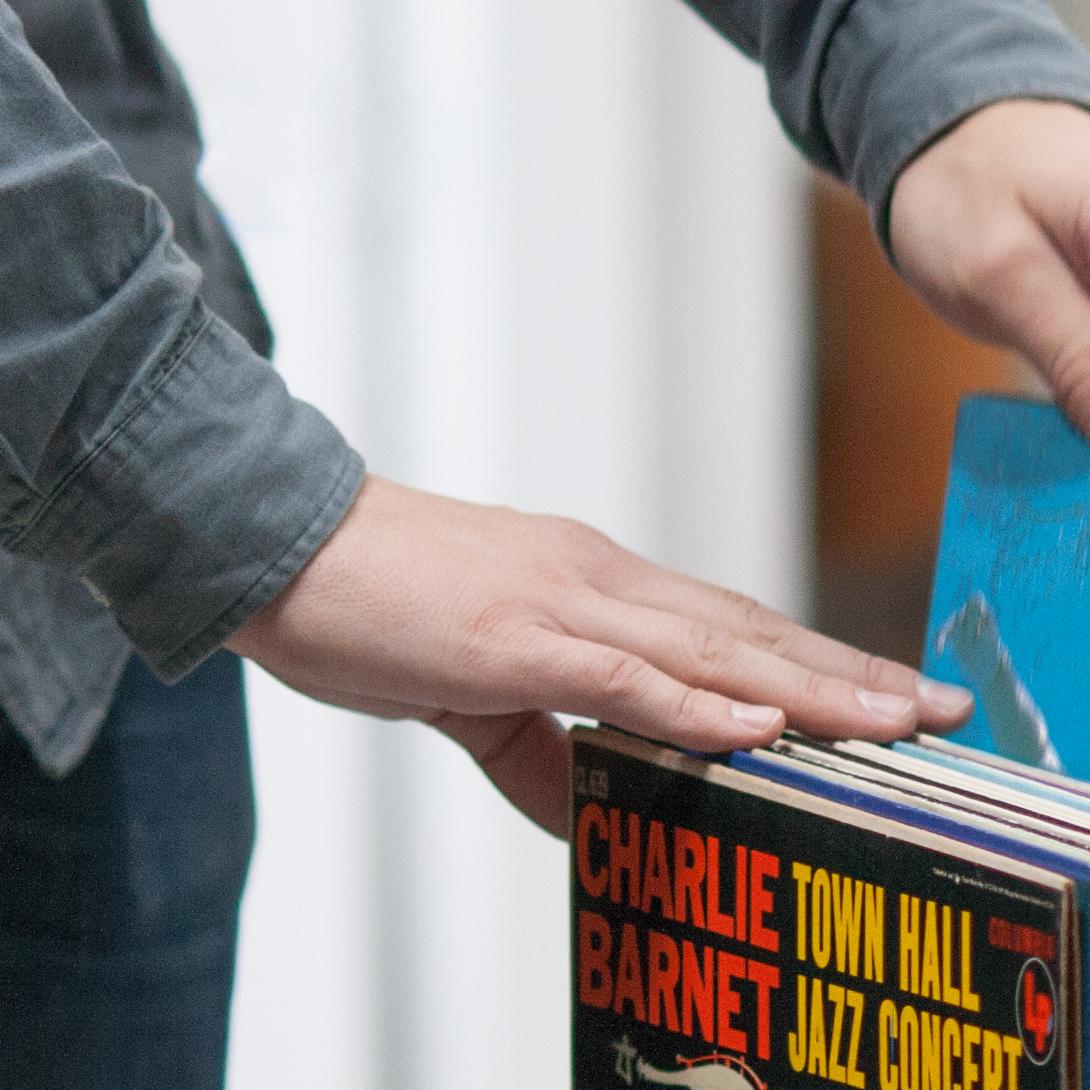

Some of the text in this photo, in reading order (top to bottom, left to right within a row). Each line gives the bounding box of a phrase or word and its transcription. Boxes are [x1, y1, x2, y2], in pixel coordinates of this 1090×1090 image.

[575, 801, 780, 953] CHARLIE
[792, 861, 981, 1012] TOWN HALL
[578, 910, 780, 1062] BARNET
[788, 974, 867, 1090] JAZZ
